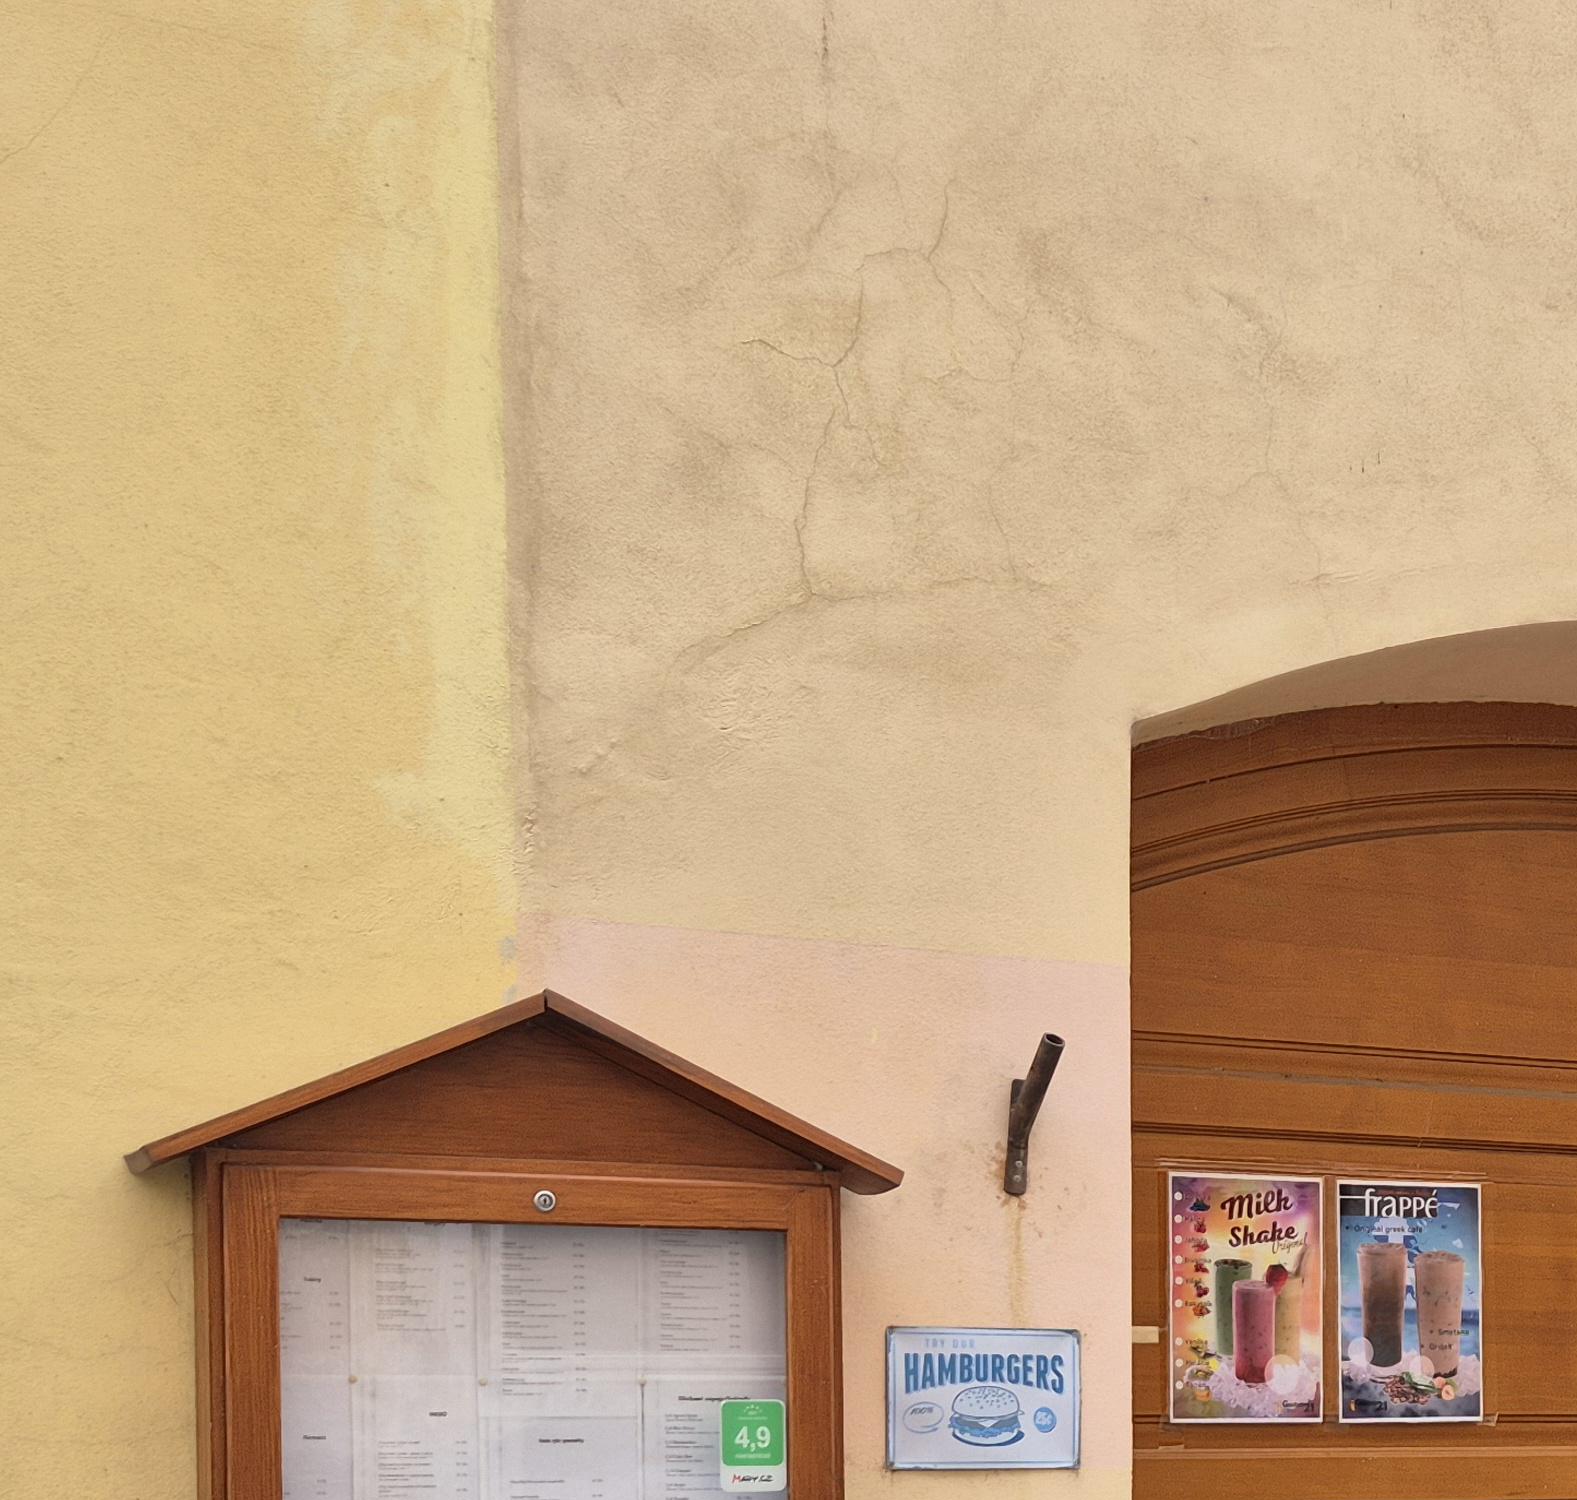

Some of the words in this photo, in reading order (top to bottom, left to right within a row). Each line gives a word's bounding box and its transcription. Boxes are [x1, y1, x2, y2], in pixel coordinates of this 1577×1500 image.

[1221, 1189, 1292, 1220] Milk
[1229, 1221, 1298, 1247] Shake
[1354, 1225, 1384, 1234] Original
[1385, 1225, 1406, 1234] greek
[924, 1338, 945, 1349] TRY
[952, 1338, 975, 1349] OUR
[904, 1352, 1064, 1395] HAMBURGERS
[734, 1425, 771, 1452] 4,9
